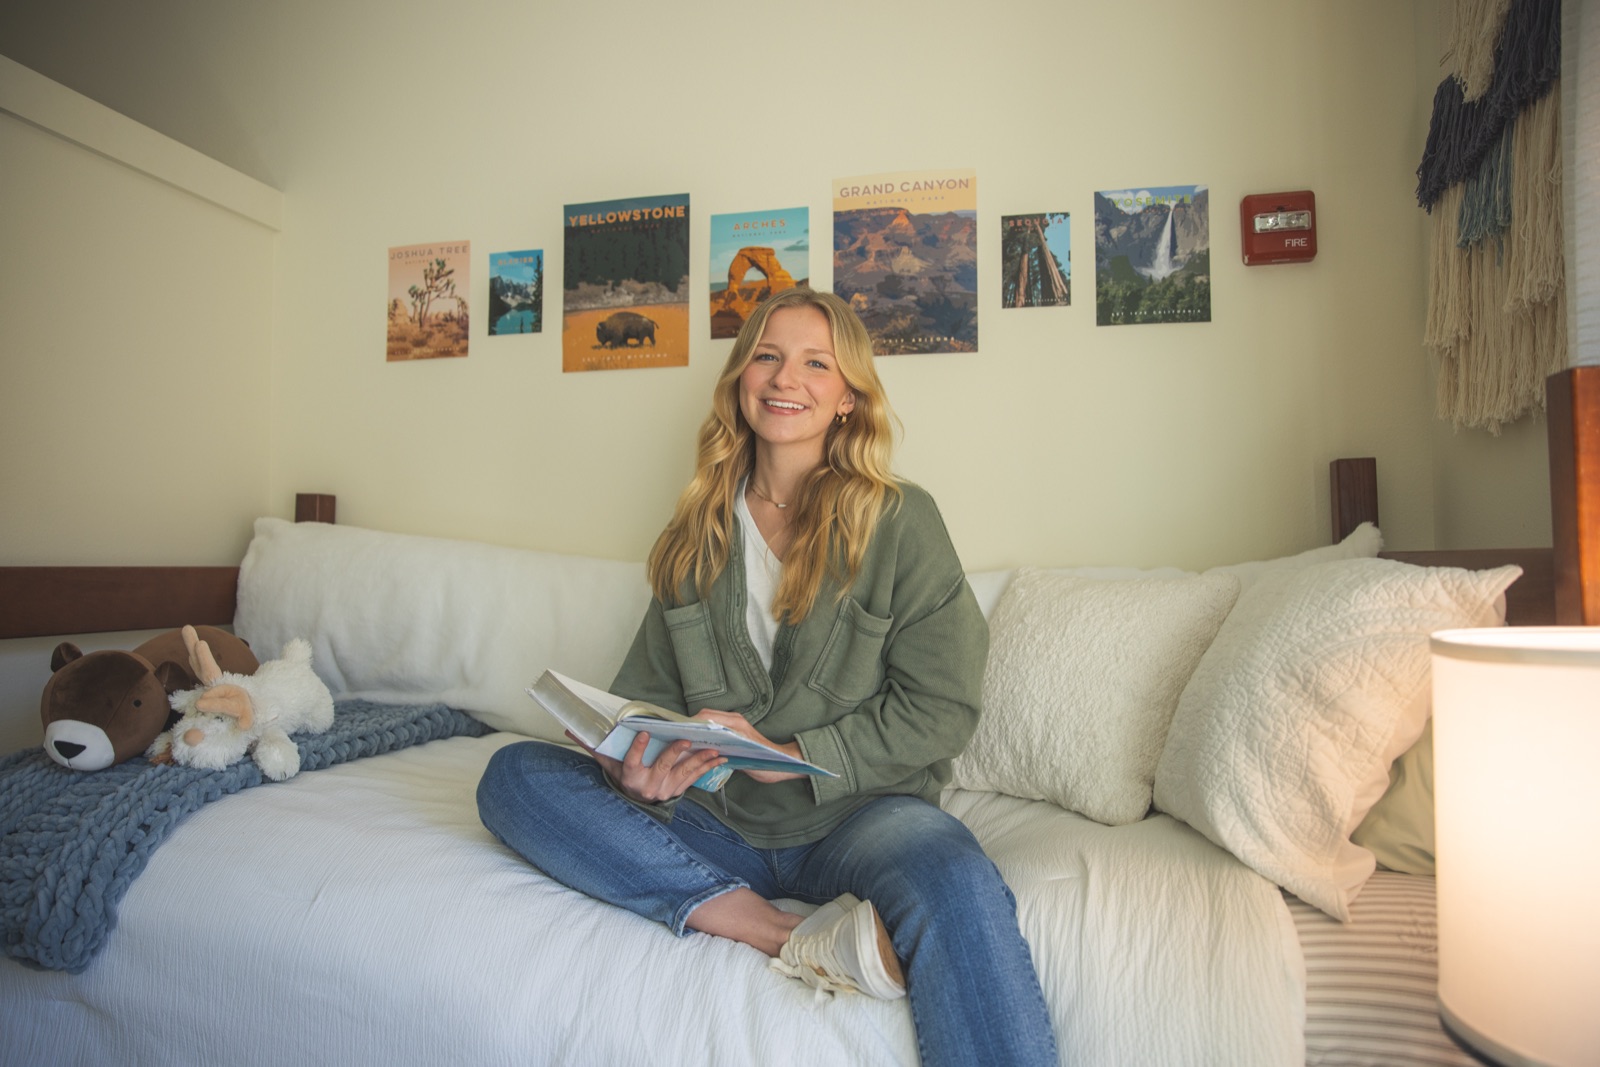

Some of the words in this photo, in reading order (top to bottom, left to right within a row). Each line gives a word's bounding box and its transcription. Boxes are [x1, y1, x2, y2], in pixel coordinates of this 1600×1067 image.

[839, 183, 895, 198] GRAND
[900, 178, 969, 192] CANYON
[1113, 193, 1192, 209] YOSEMITE
[569, 205, 686, 227] YELLOWSTONE
[1008, 217, 1063, 227] SEQUOIA
[733, 219, 786, 231] ARCHES
[1284, 237, 1308, 248] FIRE
[389, 248, 433, 260] JOSHUA
[439, 245, 468, 255] TREE
